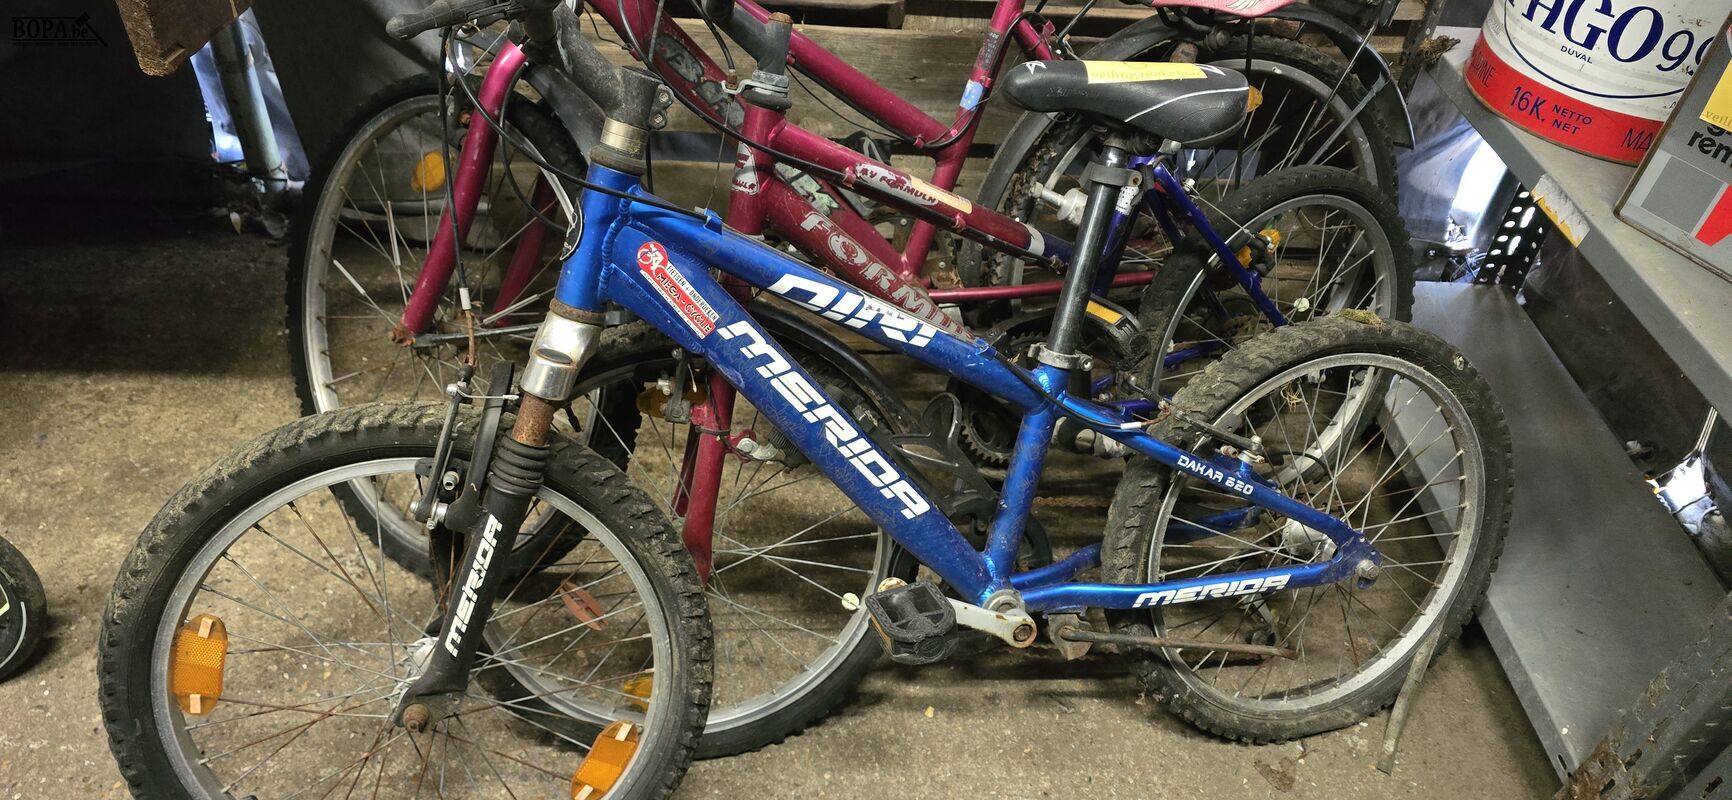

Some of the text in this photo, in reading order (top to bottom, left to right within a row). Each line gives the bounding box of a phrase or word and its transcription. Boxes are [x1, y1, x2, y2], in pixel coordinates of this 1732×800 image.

[1560, 45, 1593, 64] DUVAL
[1552, 104, 1592, 125] NETTO
[1552, 118, 1580, 135] NET
[717, 320, 931, 520] MERIDA
[1177, 455, 1254, 495] DAKAR 620
[445, 514, 503, 657] MERIDA
[1132, 574, 1291, 608] MERIDA
